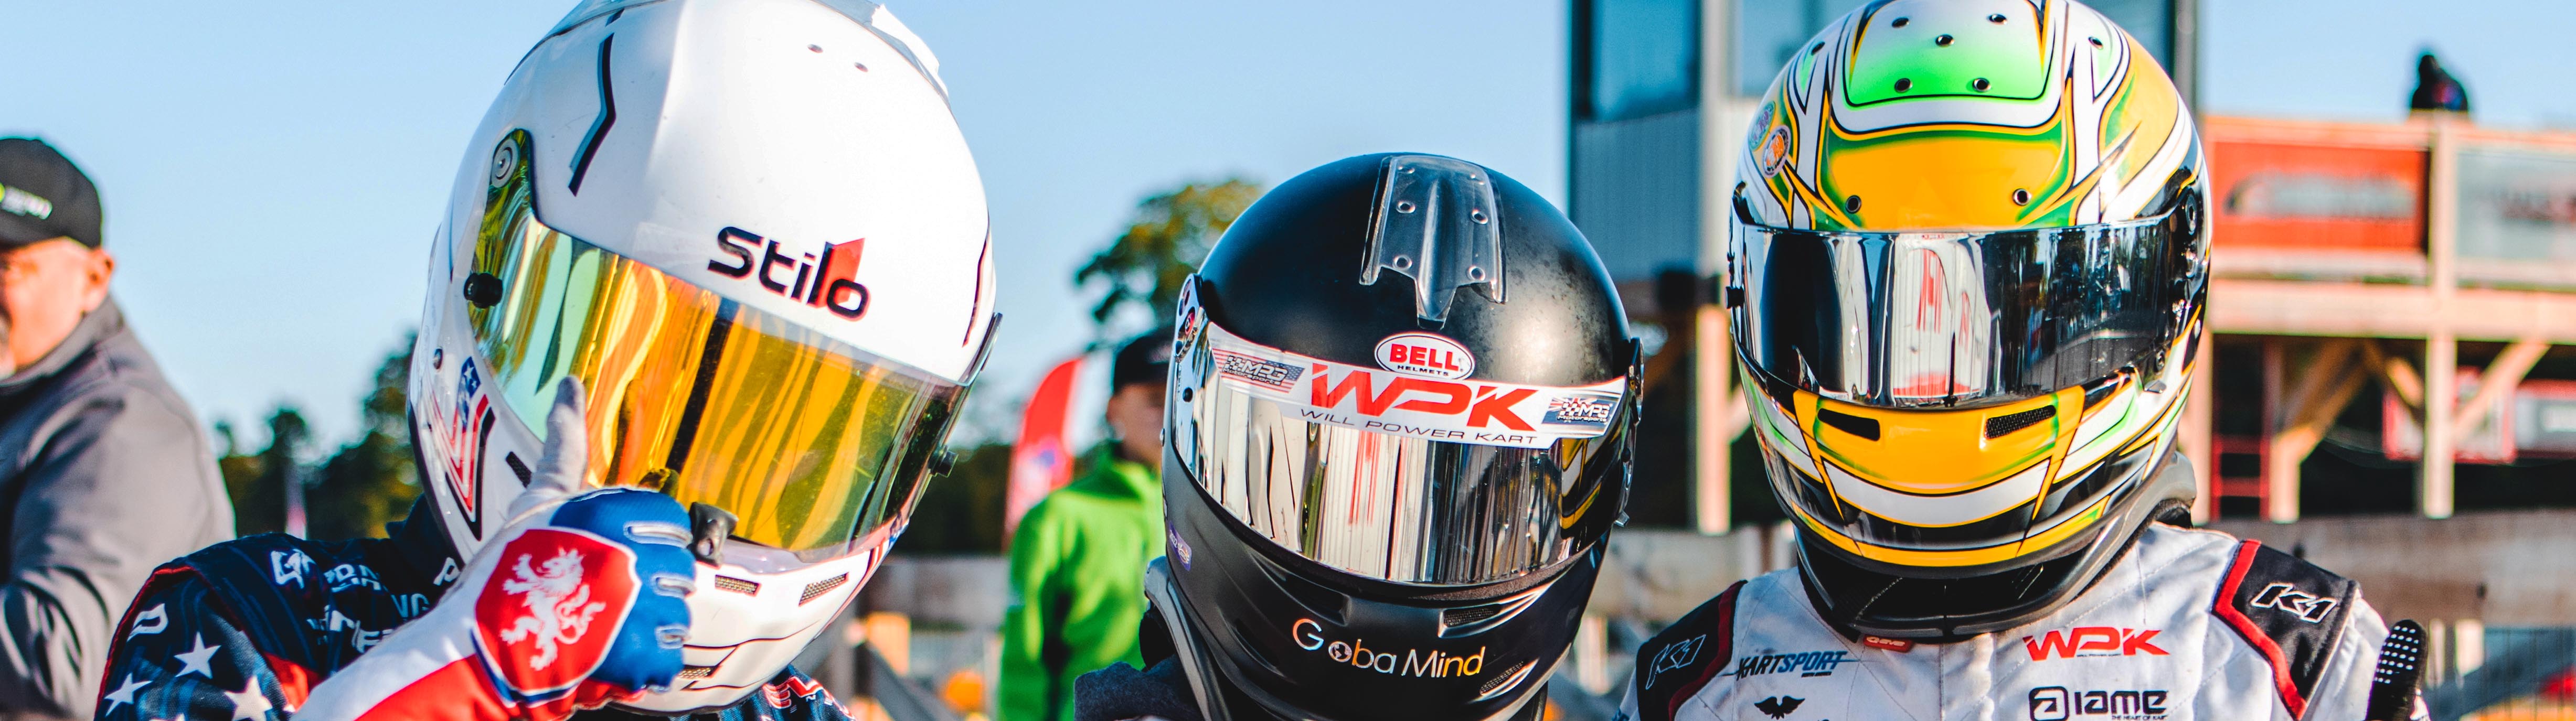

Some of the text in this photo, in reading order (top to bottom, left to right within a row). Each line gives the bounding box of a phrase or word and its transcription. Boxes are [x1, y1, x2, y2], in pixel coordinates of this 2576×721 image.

[707, 226, 871, 322] Stilo
[1390, 343, 1459, 371] BELL
[1398, 365, 1449, 376] HELMETS
[1221, 367, 1282, 386] Motorsports
[1312, 363, 1540, 432] WPK
[1301, 408, 1537, 444] WILL POWER KART
[2250, 582, 2337, 623] K1
[2022, 627, 2170, 662] WPK
[1401, 646, 1486, 678] Mind
[1736, 650, 1848, 681] KARTSPORT
